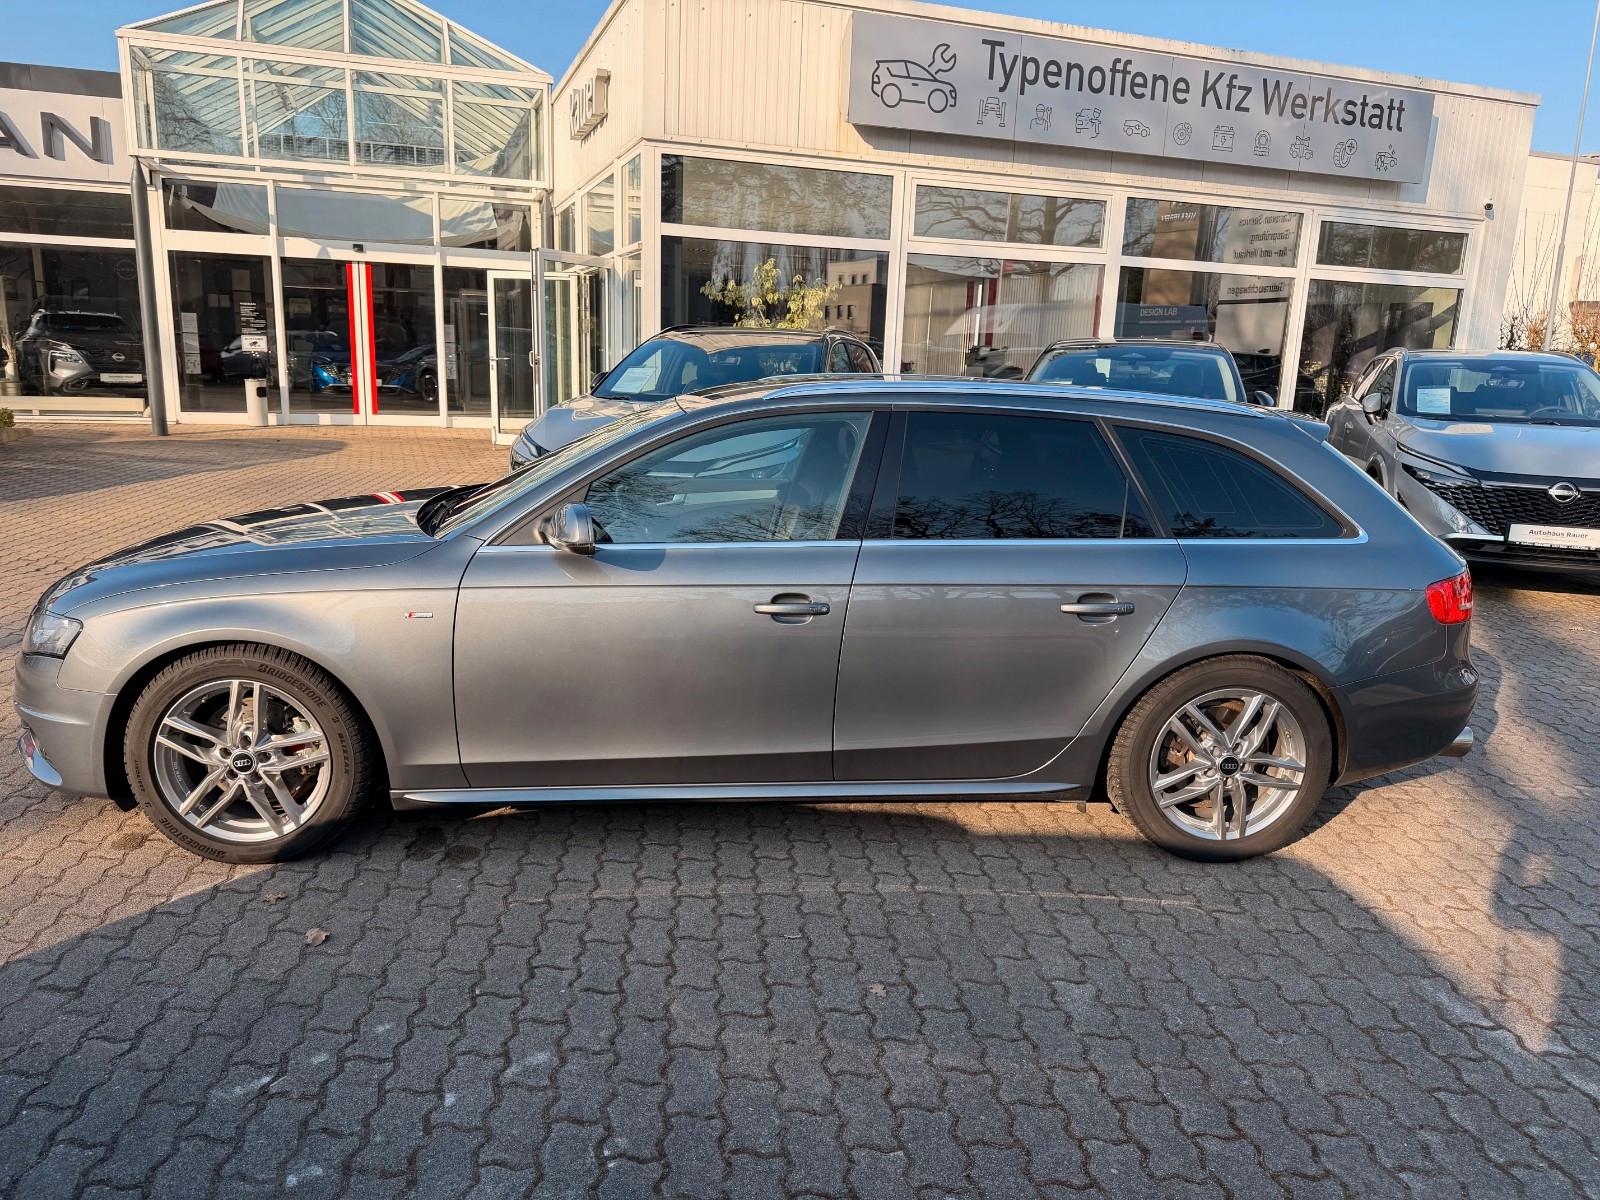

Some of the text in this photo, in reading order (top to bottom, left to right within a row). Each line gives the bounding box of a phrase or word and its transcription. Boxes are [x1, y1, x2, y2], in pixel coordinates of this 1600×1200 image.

[981, 38, 1406, 133] Typenoffene Kfz Werkstatt
[1164, 307, 1178, 316] LAB
[1528, 529, 1565, 537] Autohaus
[257, 663, 327, 708] BRIDGESTONE
[159, 817, 228, 859] BRIDGESTONE
